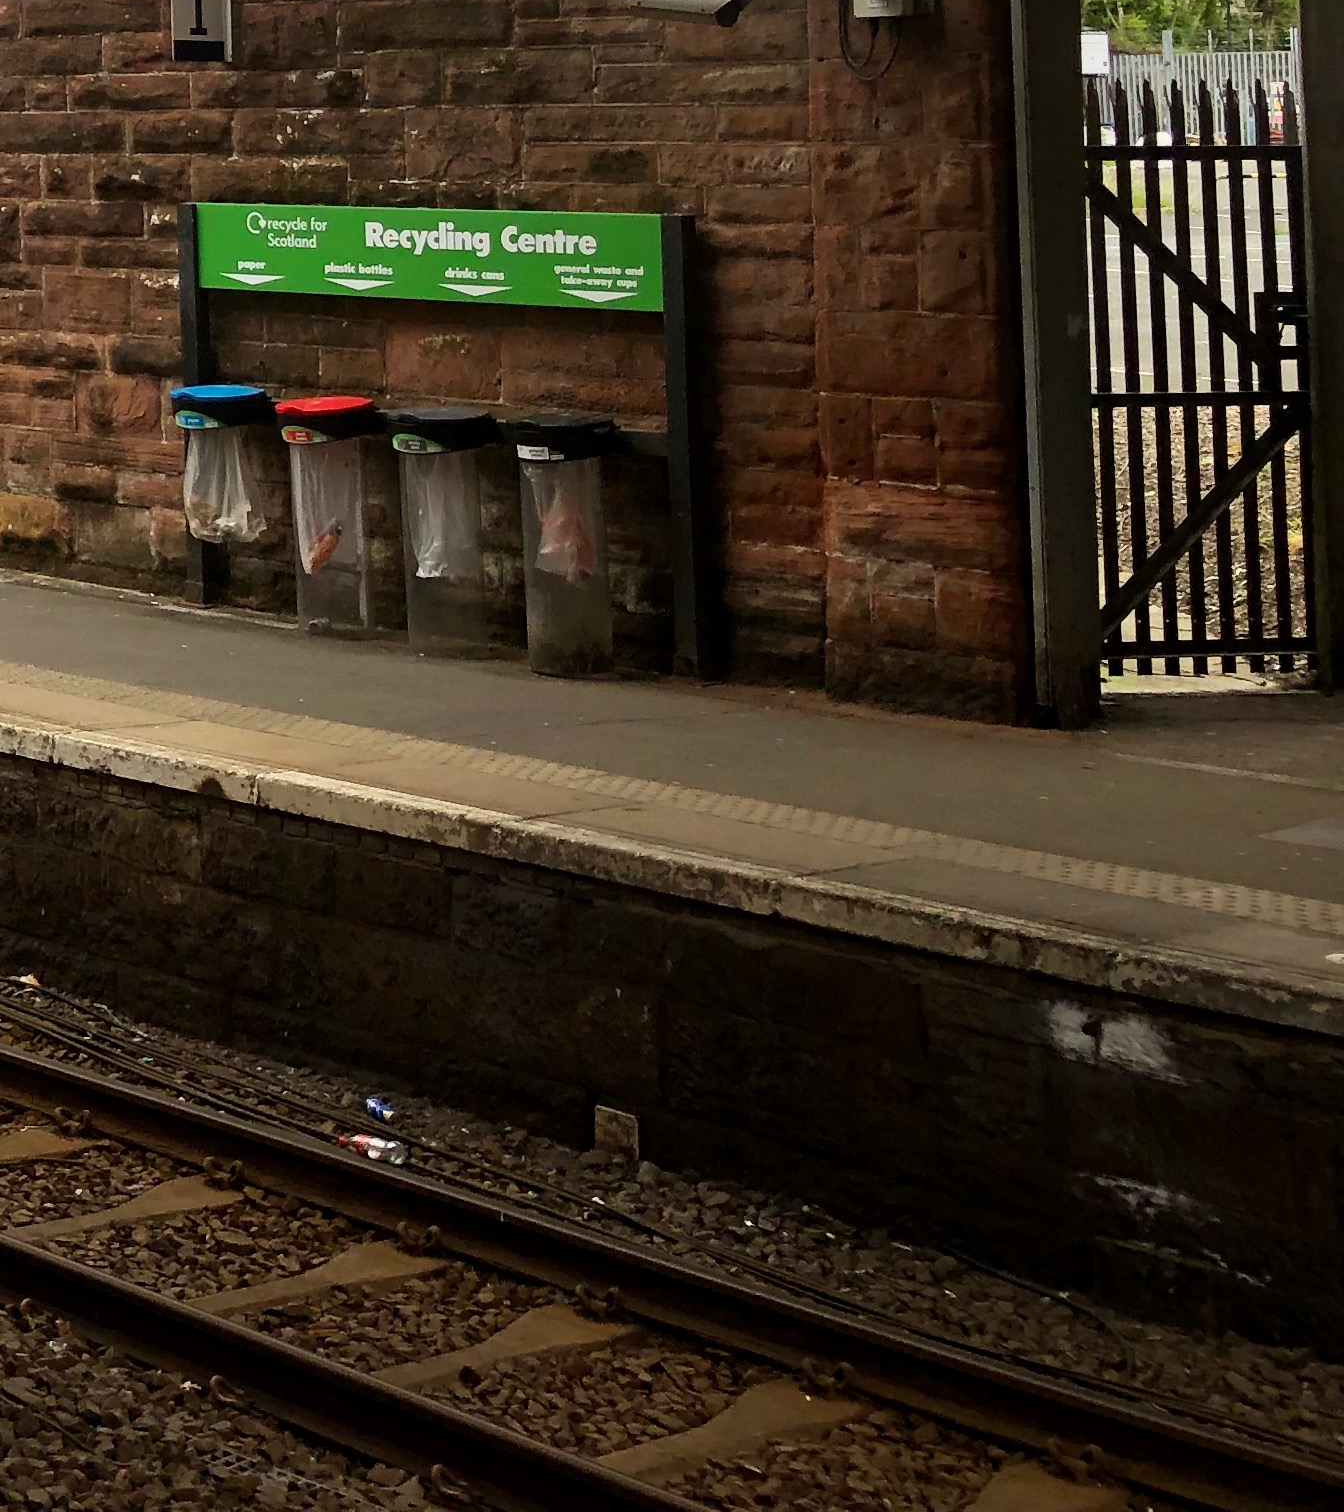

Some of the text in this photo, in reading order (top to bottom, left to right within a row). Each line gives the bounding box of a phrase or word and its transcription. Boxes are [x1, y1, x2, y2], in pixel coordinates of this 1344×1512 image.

[267, 217, 327, 233] recycle for
[267, 233, 317, 248] Scotland
[365, 221, 598, 258] Recycling Centre
[237, 260, 266, 271] paper
[324, 261, 394, 276] plastic bottles
[553, 264, 644, 276] general waste and
[444, 266, 505, 281] drinks cans
[560, 276, 638, 289] take-away cups
